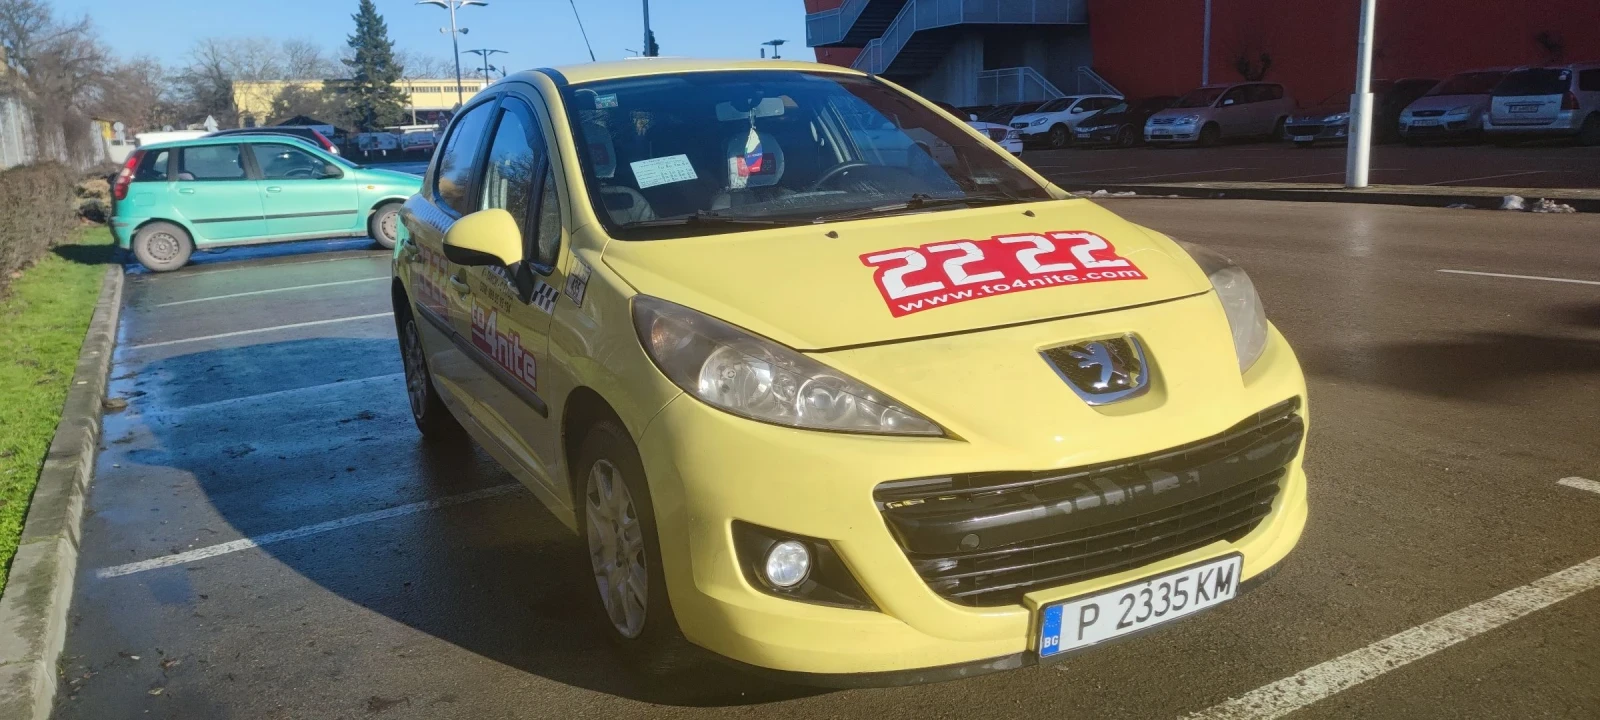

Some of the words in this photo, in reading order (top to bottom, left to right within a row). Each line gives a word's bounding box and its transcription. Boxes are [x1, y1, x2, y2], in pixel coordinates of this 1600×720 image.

[867, 241, 1005, 300] 22
[1000, 232, 1130, 275] 22
[898, 269, 1140, 312] www.to4nite.com
[1077, 603, 1100, 641] P
[1116, 576, 1190, 630] 2335
[1194, 563, 1235, 605] KM
[1044, 635, 1059, 648] BG
